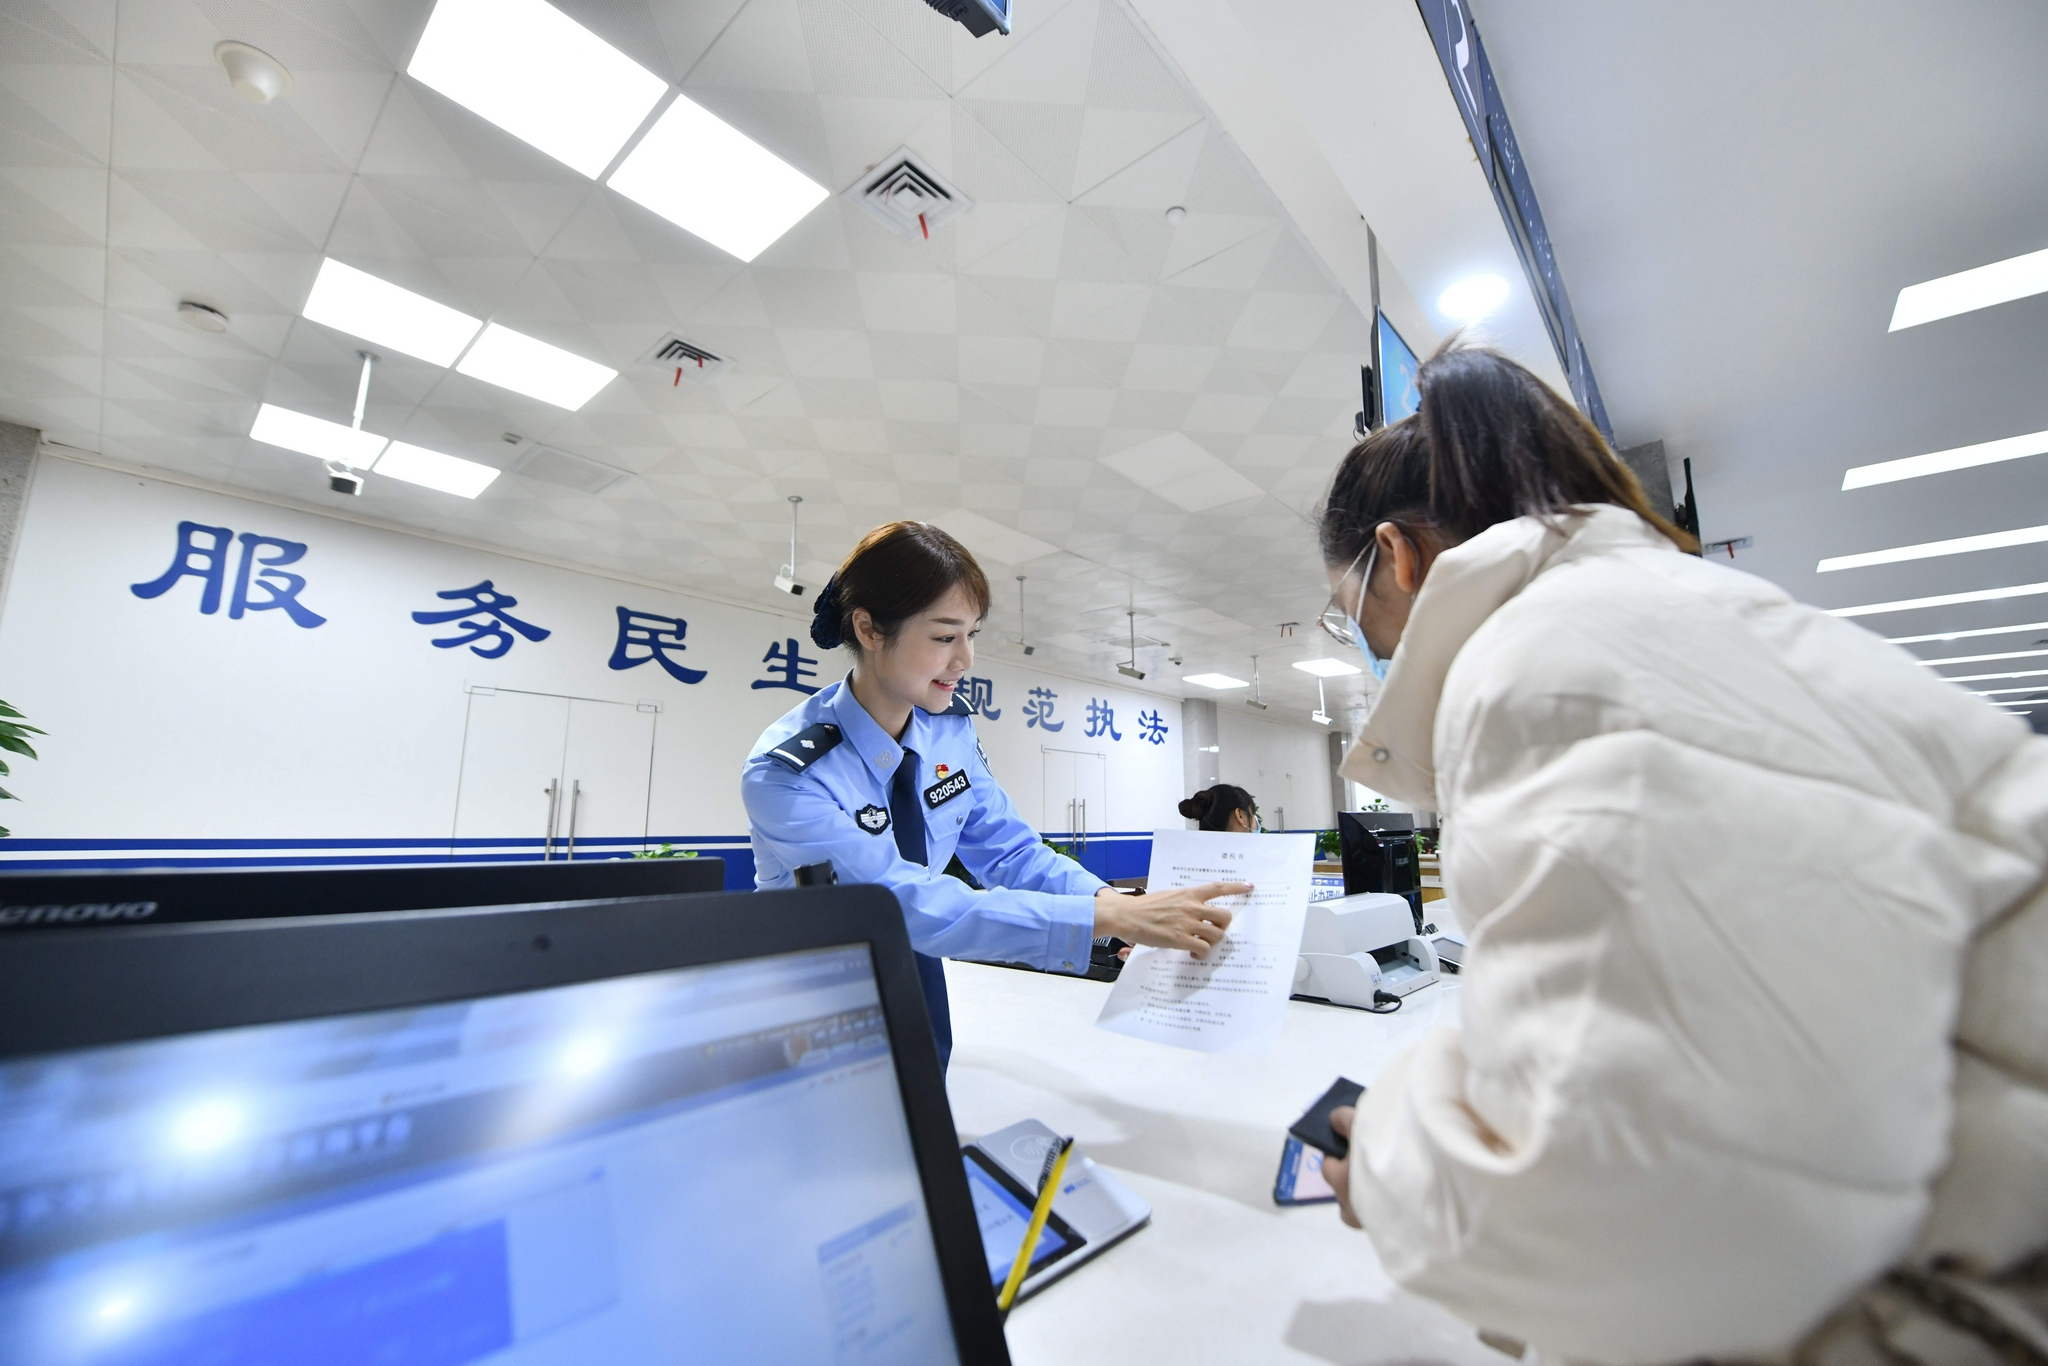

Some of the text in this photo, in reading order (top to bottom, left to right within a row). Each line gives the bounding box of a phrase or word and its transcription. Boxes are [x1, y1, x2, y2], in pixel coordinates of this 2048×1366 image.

[131, 521, 1169, 745] 服务民生 规范执法
[929, 775, 966, 803] 920543
[0, 901, 158, 925] enovo
